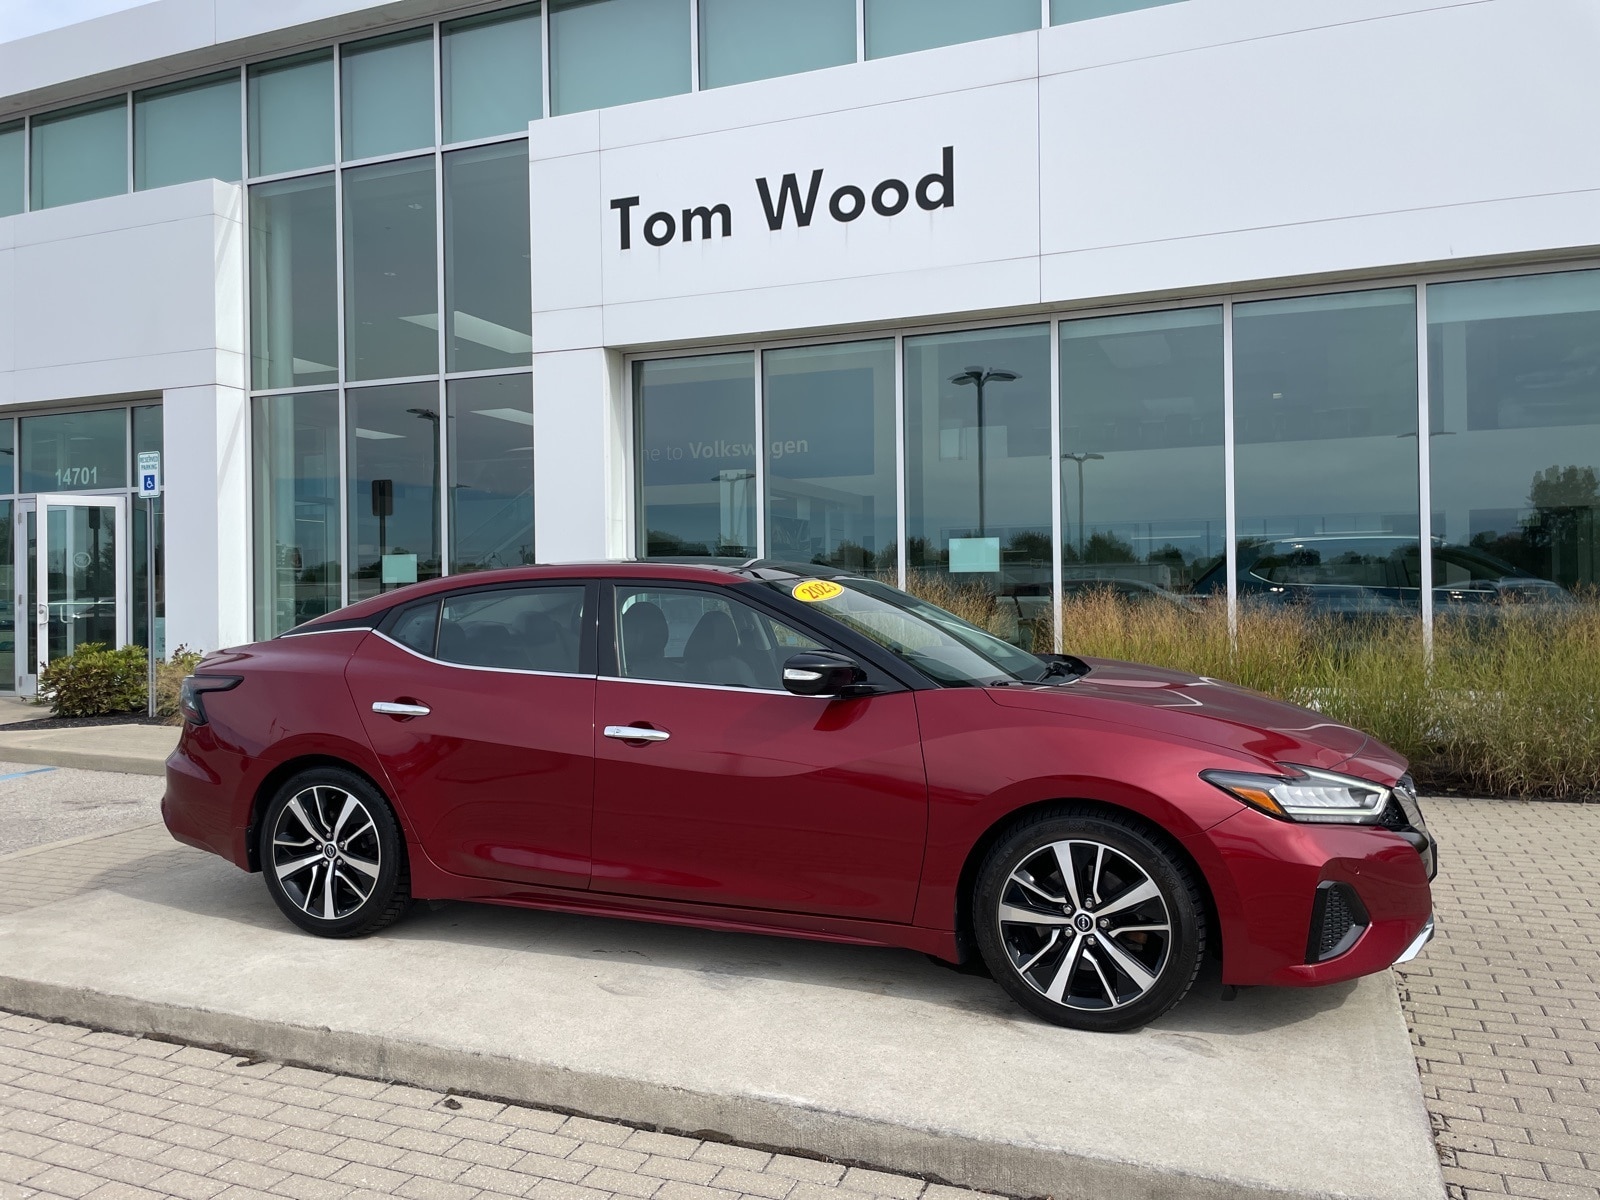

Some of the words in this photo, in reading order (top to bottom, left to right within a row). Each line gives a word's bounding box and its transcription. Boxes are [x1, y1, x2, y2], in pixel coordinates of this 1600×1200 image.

[610, 195, 732, 250] Tom
[755, 145, 955, 231] Wood
[666, 444, 683, 461] to
[688, 439, 809, 459] Volkswgen
[55, 467, 97, 486] 14701
[801, 582, 837, 599] 2023
